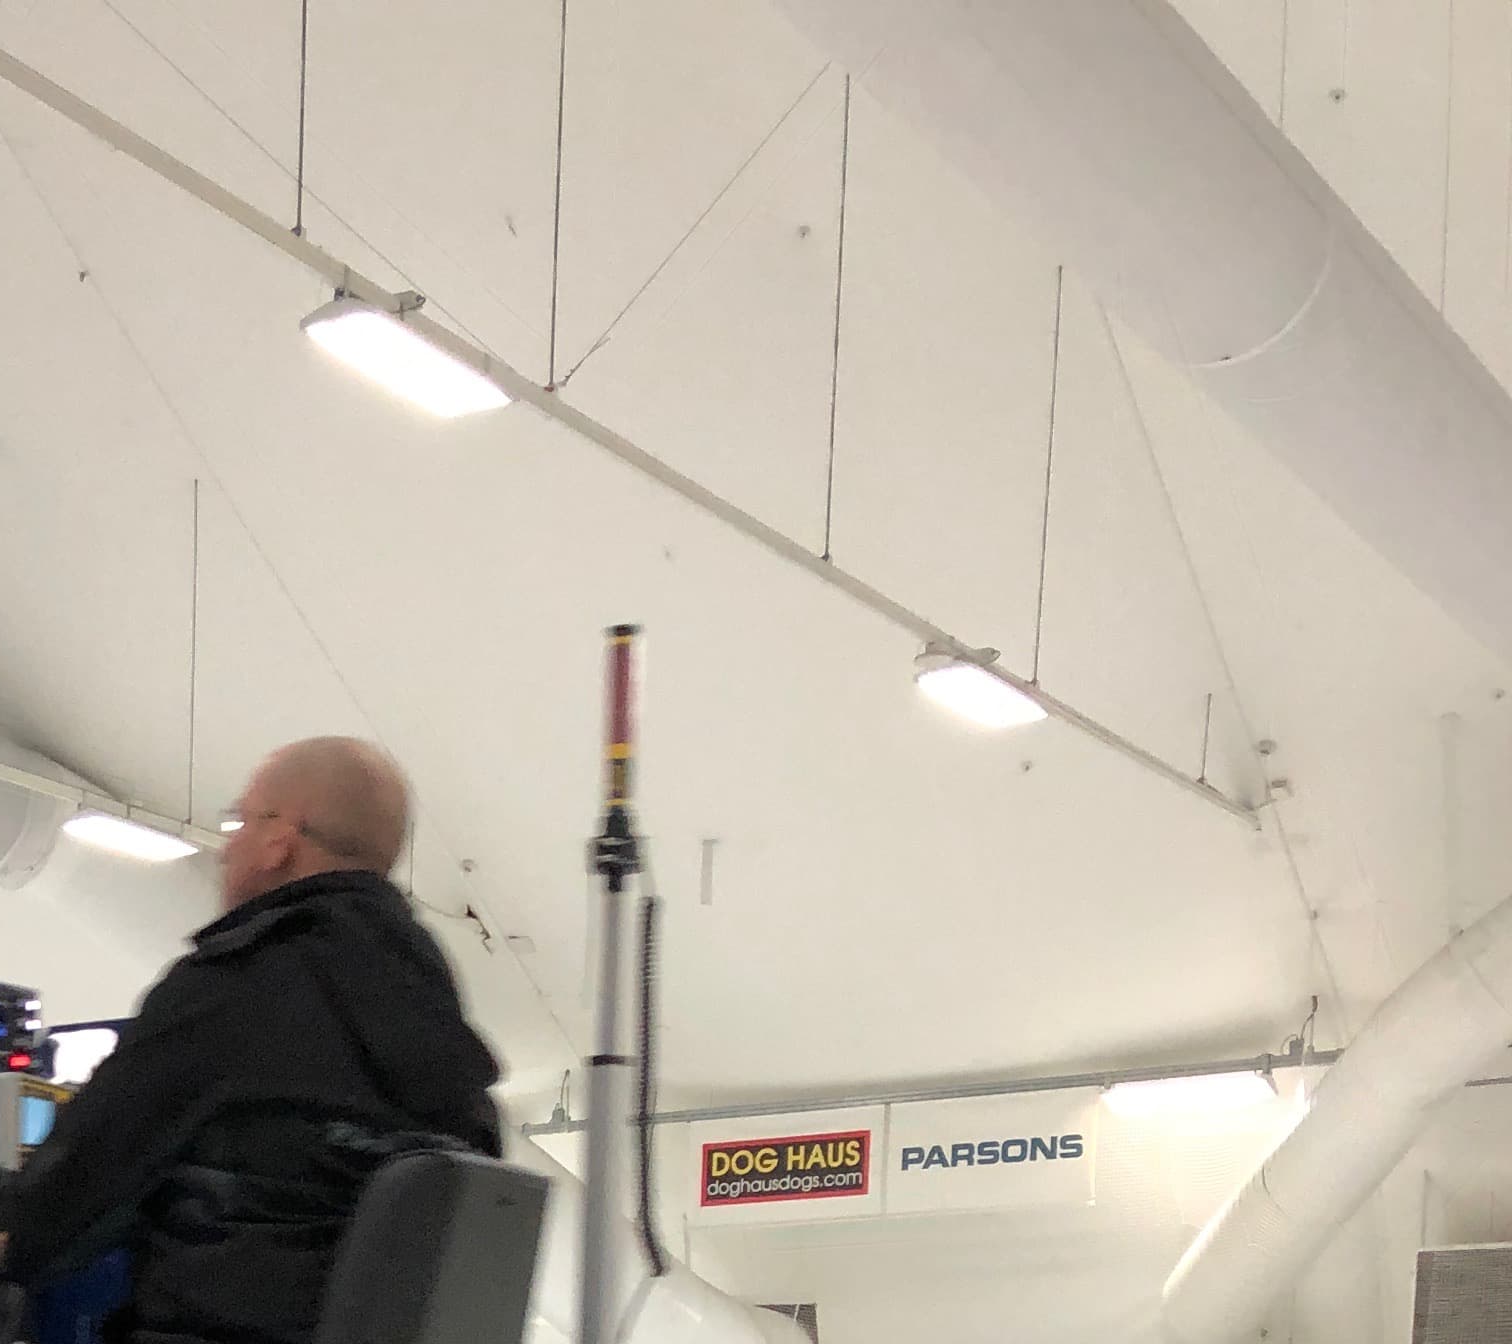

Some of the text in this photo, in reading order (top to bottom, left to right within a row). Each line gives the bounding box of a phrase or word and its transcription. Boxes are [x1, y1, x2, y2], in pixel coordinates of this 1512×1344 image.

[711, 1140, 861, 1177] DOG HAUS
[901, 1134, 1084, 1171] PARSONS
[707, 1171, 862, 1197] doghausdogs.com
